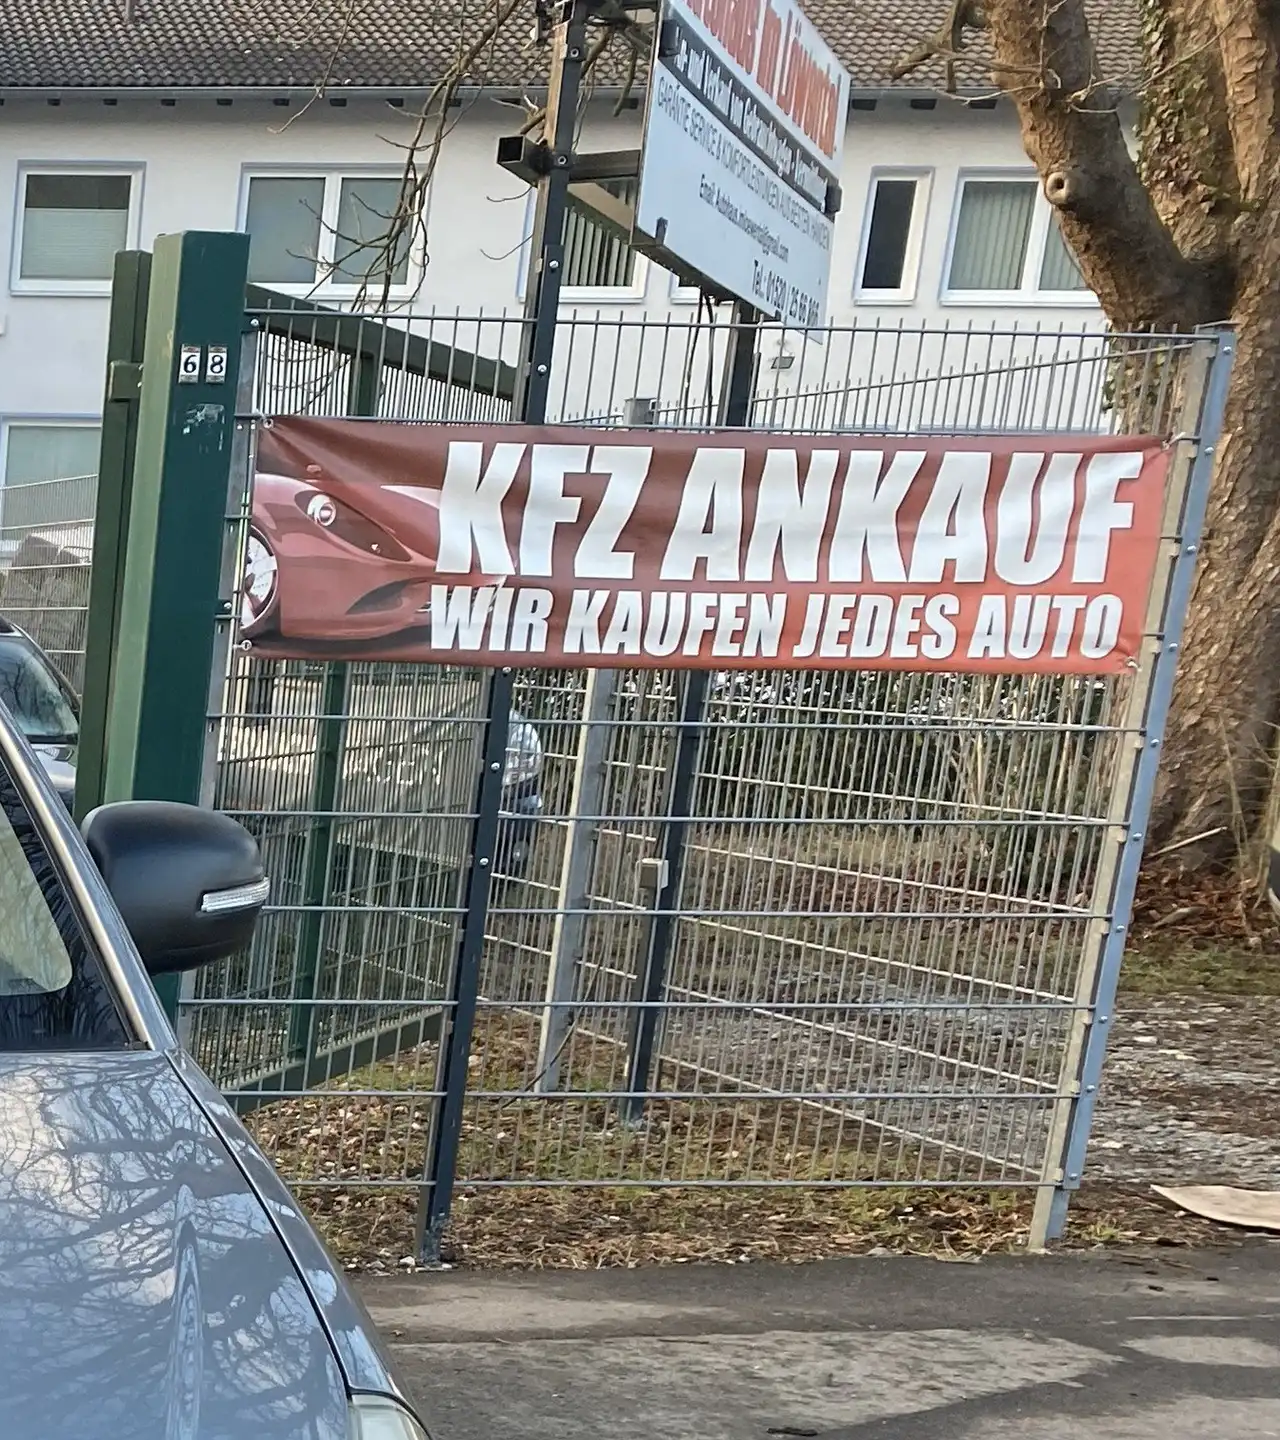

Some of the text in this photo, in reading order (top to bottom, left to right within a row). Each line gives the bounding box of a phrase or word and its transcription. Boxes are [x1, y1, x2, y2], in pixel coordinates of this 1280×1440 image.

[183, 354, 224, 374] 68
[436, 441, 1144, 585] KFZ ANKAUF
[431, 584, 1124, 660] WIR KAUFEN JEDES AUTO
